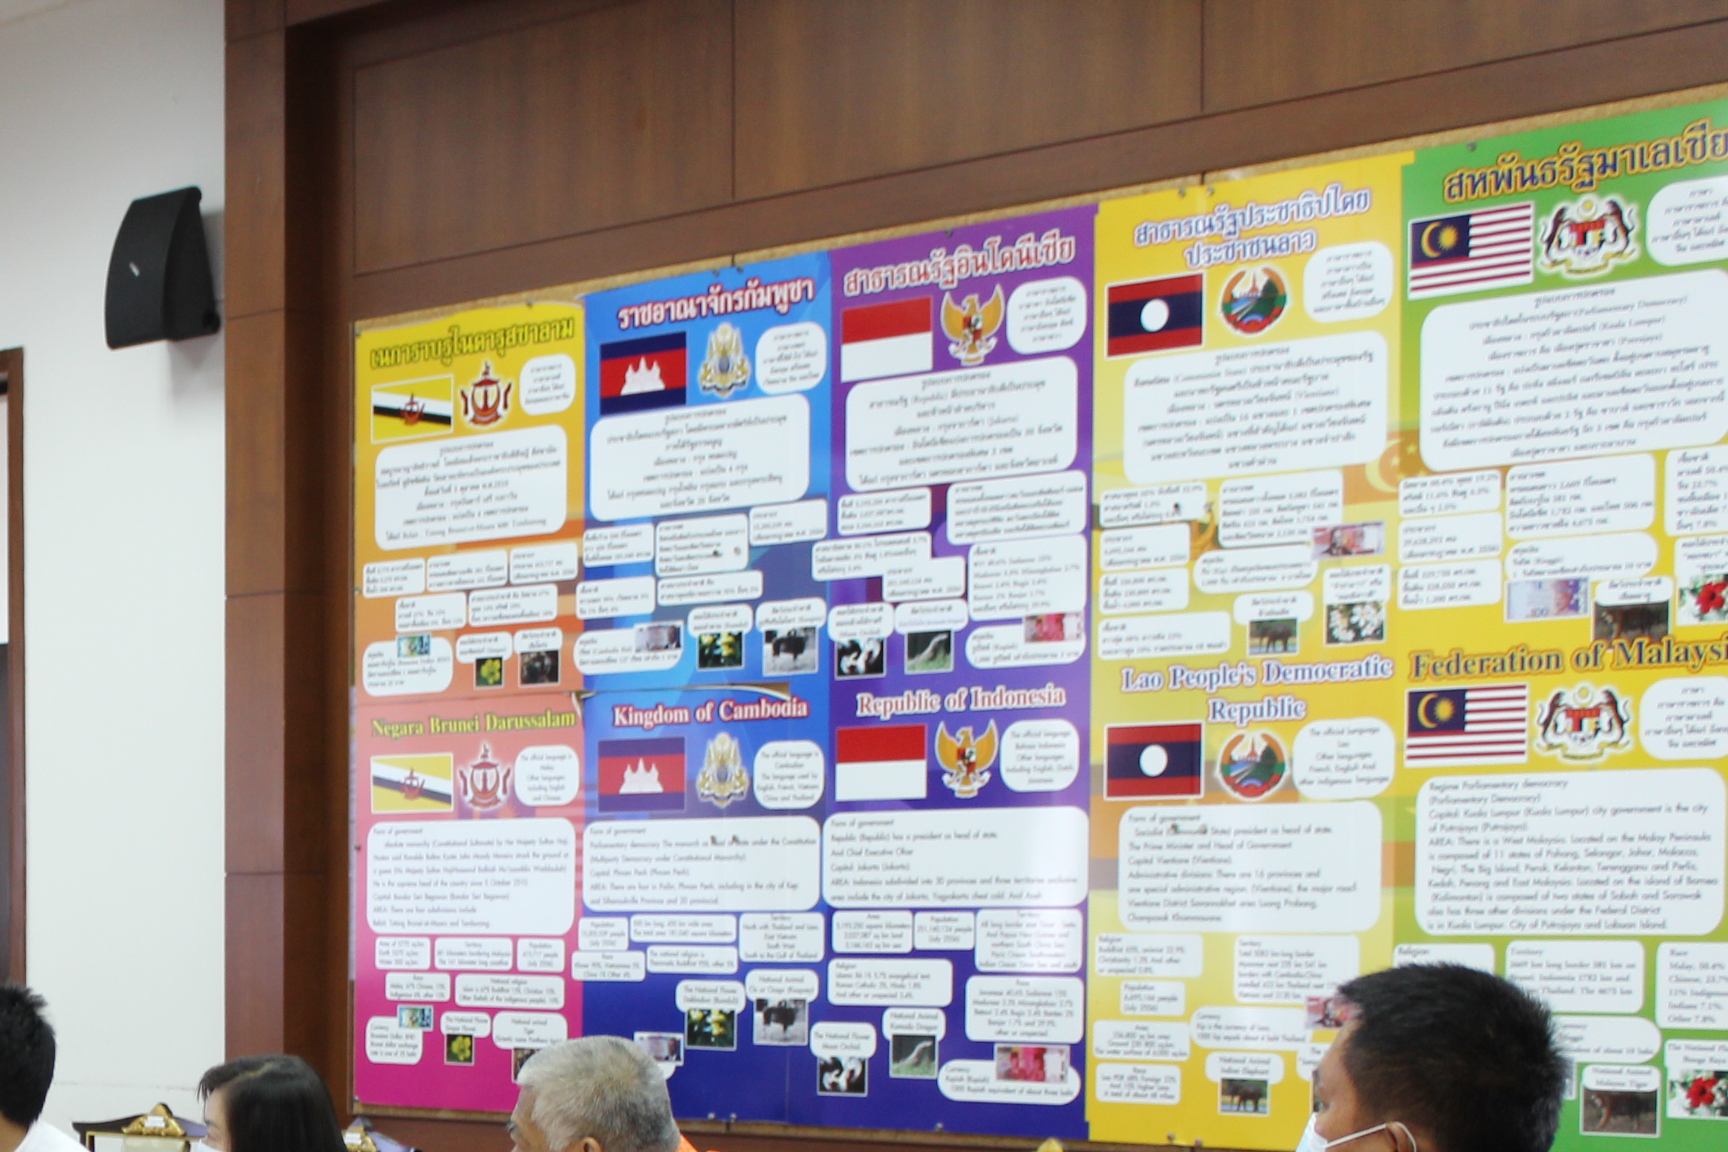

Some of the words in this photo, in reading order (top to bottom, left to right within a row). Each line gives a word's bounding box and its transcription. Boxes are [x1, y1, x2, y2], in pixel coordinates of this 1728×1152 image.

[1134, 184, 1371, 247] สาธารณรัฐประชาธิปไตย
[1185, 230, 1317, 268] ประชาชนลาว
[618, 278, 815, 330] ราชอาณาจักรกัมพูชา
[1122, 668, 1164, 691] Lao
[1169, 663, 1257, 692] People's
[1263, 656, 1393, 685] Democratic
[1409, 648, 1562, 681] Federation
[1572, 643, 1603, 669] of
[1612, 637, 1728, 671] Malaysi
[613, 704, 690, 729] Kingdom
[696, 701, 714, 722] of
[719, 696, 809, 721] Cambodia
[857, 689, 941, 720] Republic
[945, 687, 967, 712] of
[971, 683, 1066, 709] Indonesia
[1209, 695, 1306, 727] Republic
[373, 719, 425, 739] Negara
[430, 715, 480, 734] Brunei
[485, 709, 576, 732] Darussalam
